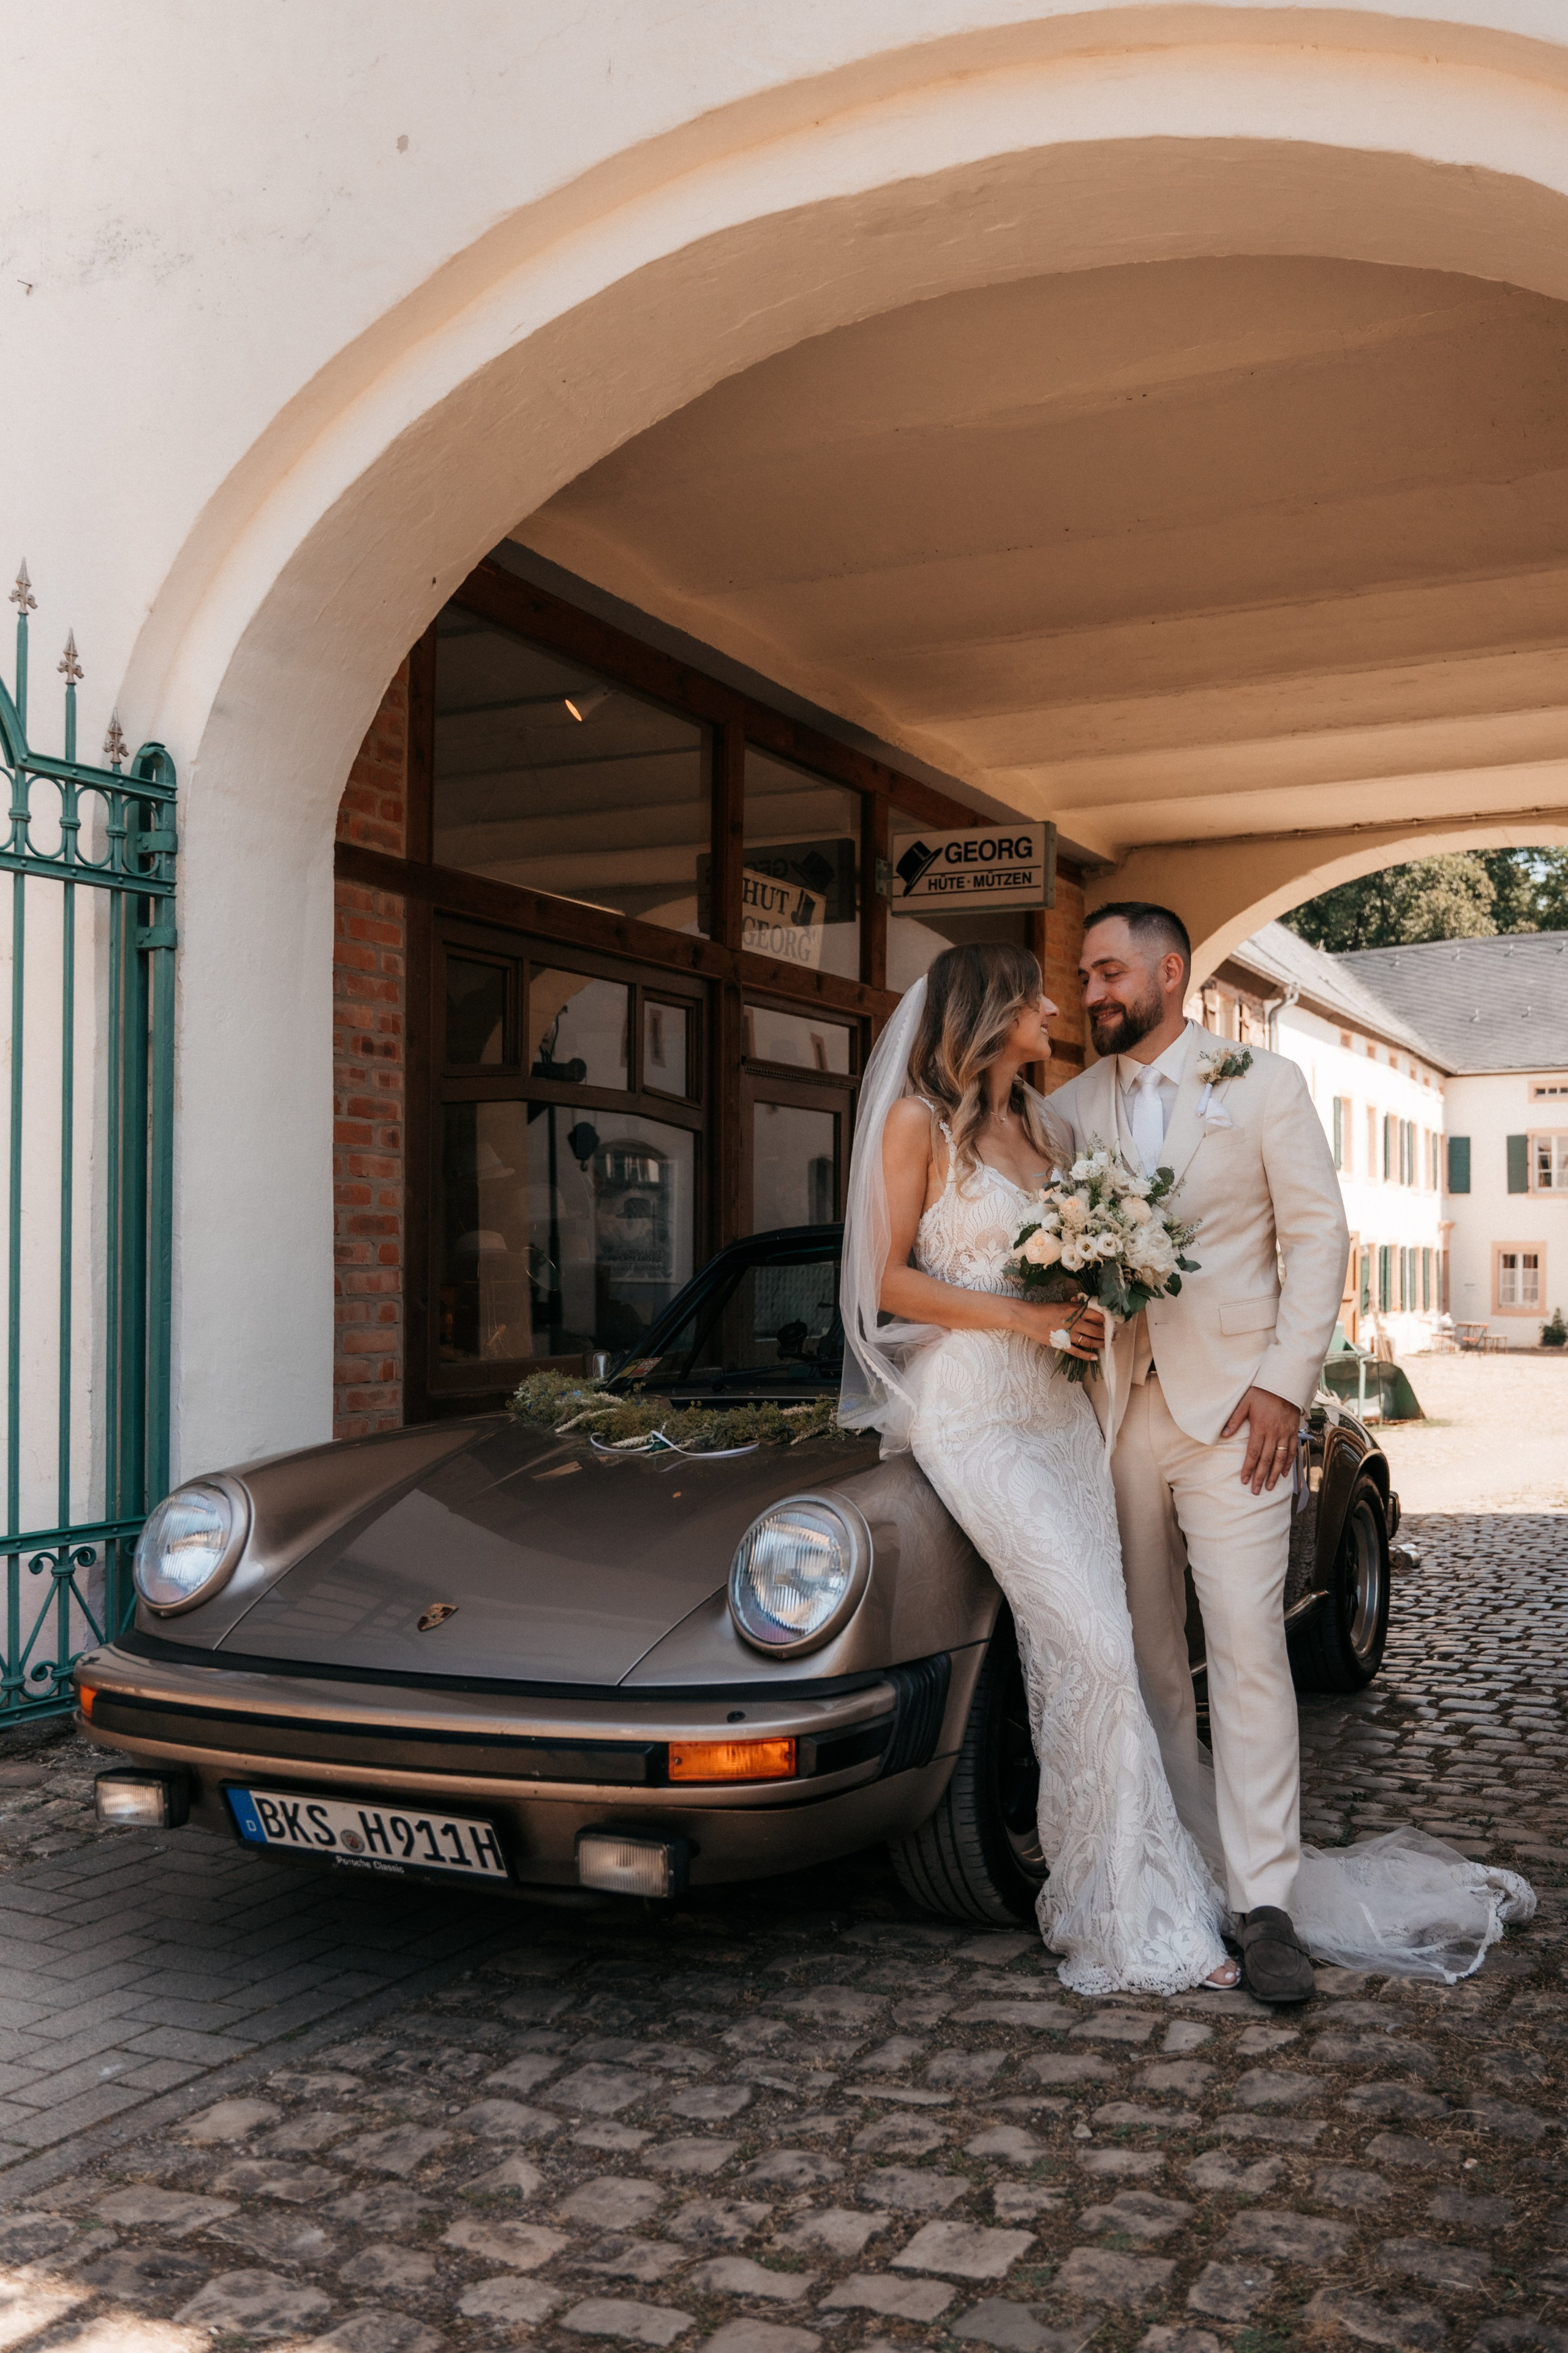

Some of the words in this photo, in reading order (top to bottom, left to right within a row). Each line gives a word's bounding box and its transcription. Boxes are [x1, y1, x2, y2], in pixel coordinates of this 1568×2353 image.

[944, 836, 1033, 864] GEORG
[928, 874, 965, 891] HÜTE
[973, 871, 1032, 888] MÜTZEN
[742, 877, 790, 915] HUT
[742, 915, 812, 962] GEORG
[246, 1819, 257, 1832] D
[254, 1797, 337, 1846] BKS
[358, 1810, 505, 1871] H911H
[336, 1855, 372, 1869] Porsche
[373, 1860, 405, 1874] Classic
